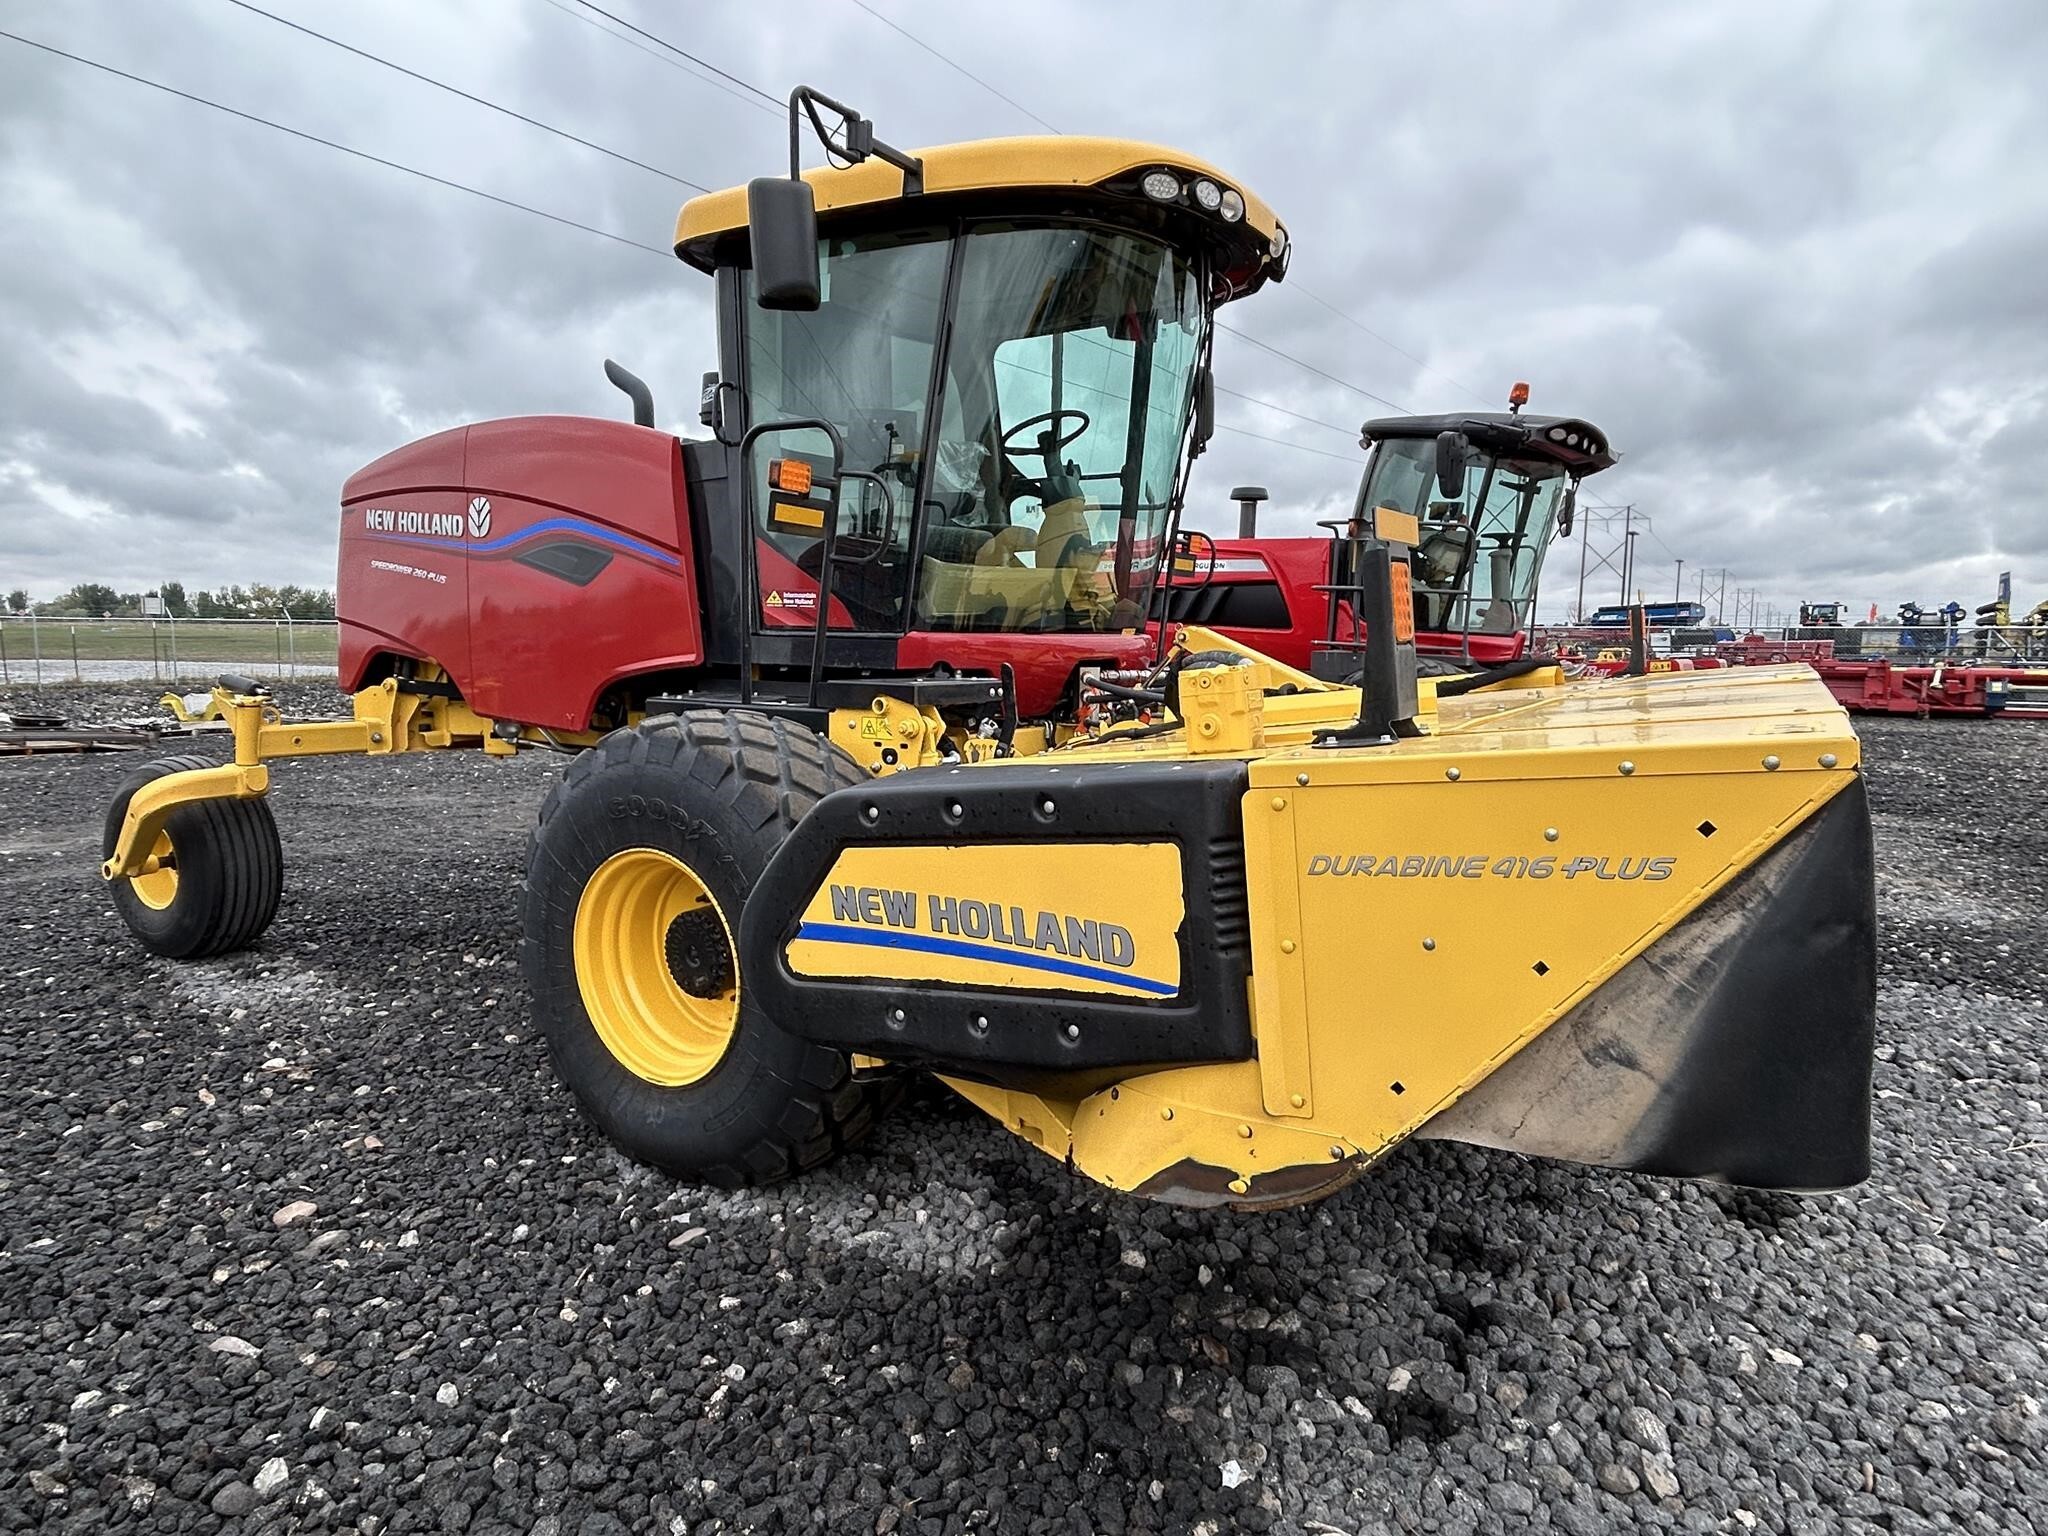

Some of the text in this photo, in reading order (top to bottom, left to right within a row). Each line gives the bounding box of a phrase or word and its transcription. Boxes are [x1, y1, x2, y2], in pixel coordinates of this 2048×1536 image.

[366, 509, 464, 536] NEW HOLLAND
[412, 568, 427, 579] 260
[1307, 855, 1488, 878] DURABINE
[1491, 856, 1557, 878] 416
[830, 884, 1135, 967] NEW HOLLAND
